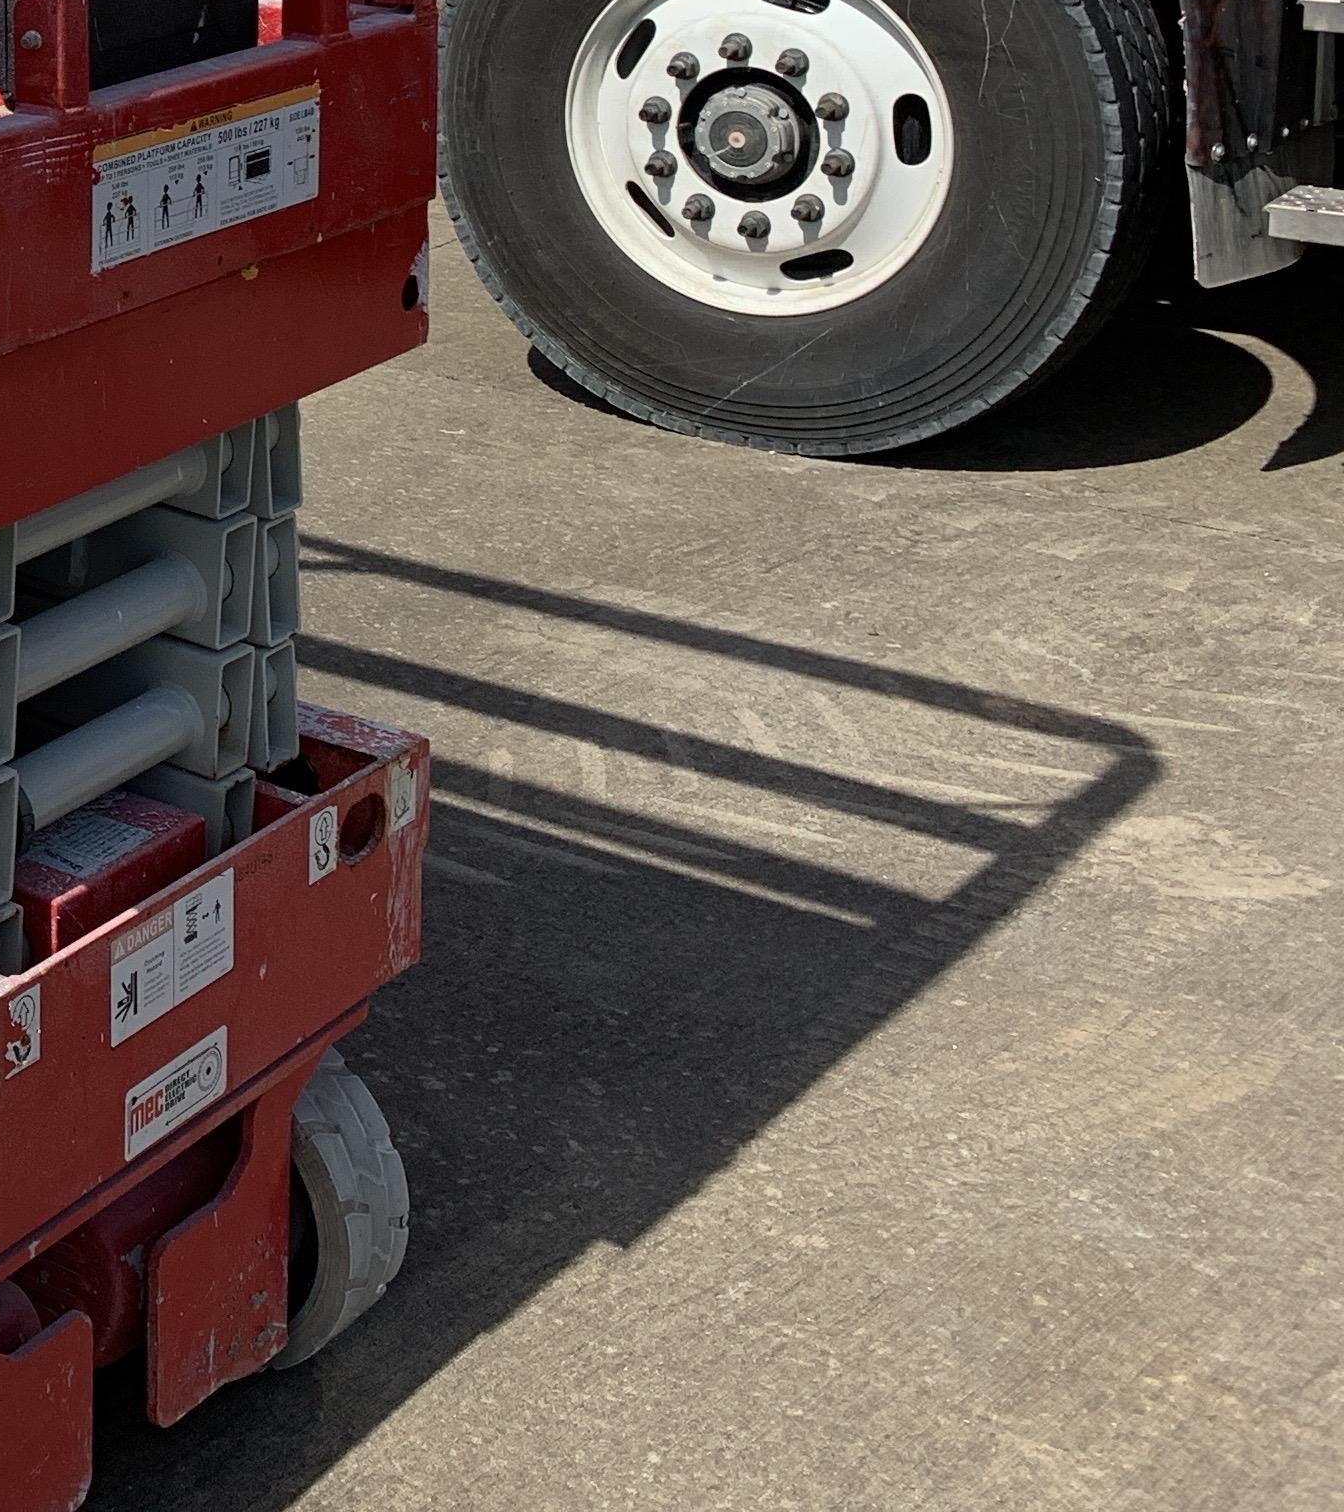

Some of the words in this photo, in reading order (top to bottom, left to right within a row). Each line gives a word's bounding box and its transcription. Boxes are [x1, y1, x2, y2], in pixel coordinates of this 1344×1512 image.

[217, 131, 233, 145] 500
[234, 126, 247, 138] lbs
[253, 119, 268, 134] 227
[270, 117, 280, 130] kg
[137, 144, 176, 162] PLATFORM
[177, 133, 211, 150] CAPACITY
[127, 909, 173, 951] DANGER
[164, 1069, 190, 1093] DIRECT
[164, 1074, 197, 1102] ELECTRIC
[131, 1088, 164, 1137] mec
[164, 1090, 186, 1112] DRIVE
